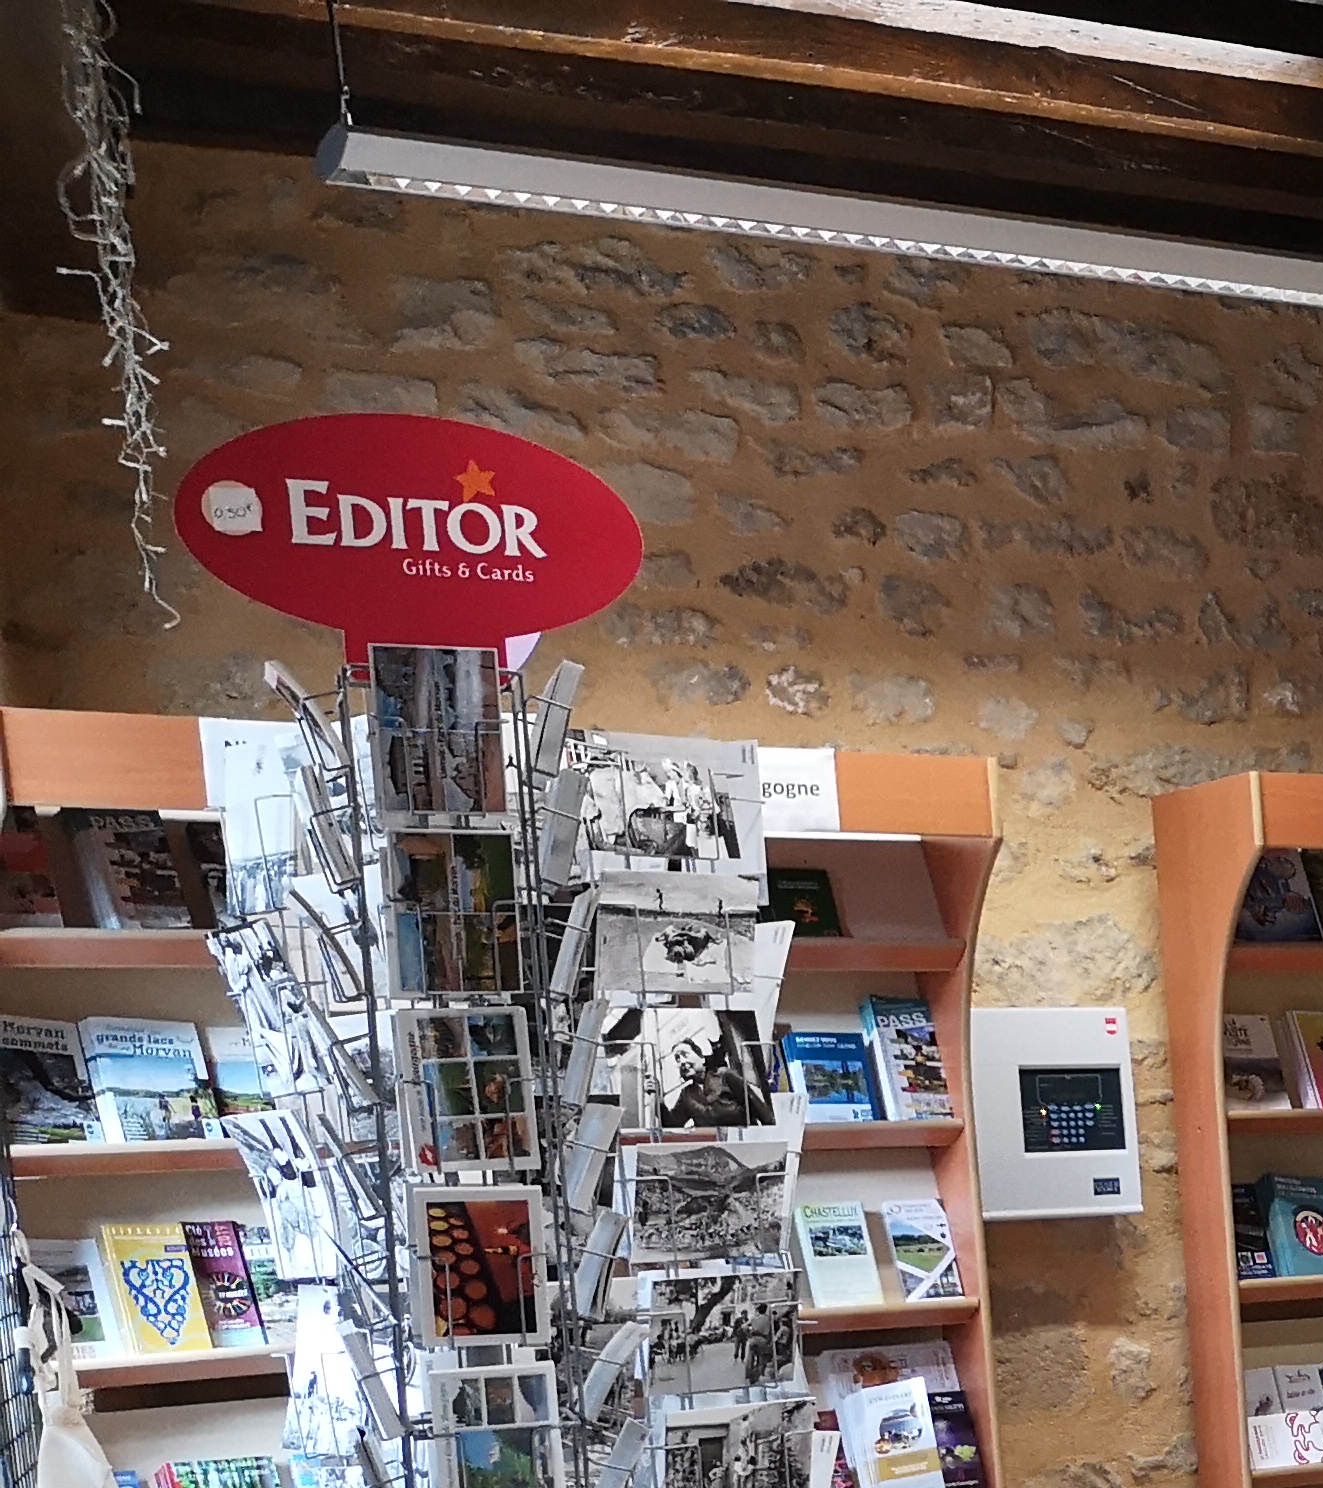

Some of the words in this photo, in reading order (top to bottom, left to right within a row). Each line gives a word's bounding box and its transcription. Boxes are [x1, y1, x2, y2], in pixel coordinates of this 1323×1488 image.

[285, 477, 547, 558] EDITOR
[402, 558, 451, 578] Gifts
[457, 562, 470, 578] &
[476, 562, 534, 582] Cards
[762, 780, 820, 799] gogne
[877, 1012, 927, 1029] PASS
[132, 1043, 192, 1058] Morvan
[802, 1205, 859, 1219] CHASTELLUX
